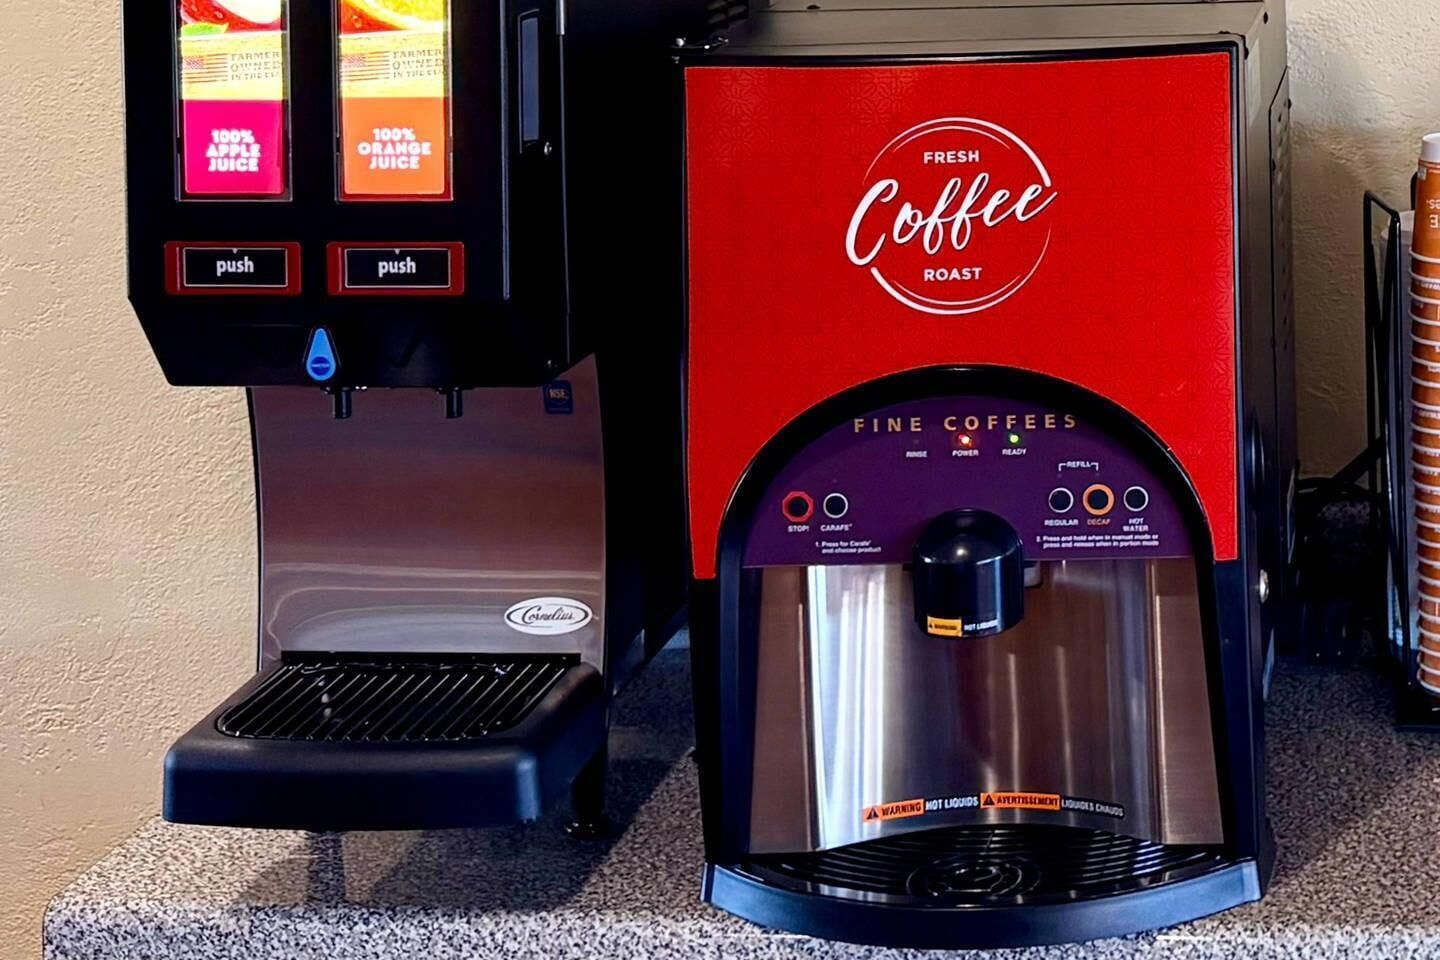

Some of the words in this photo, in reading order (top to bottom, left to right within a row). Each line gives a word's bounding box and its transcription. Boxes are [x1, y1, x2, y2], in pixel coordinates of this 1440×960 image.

[211, 129, 255, 144] 100%
[373, 128, 416, 141] 100%
[206, 143, 261, 158] APPLE
[357, 141, 432, 156] ORANGE
[208, 157, 259, 172] JUICE
[369, 155, 420, 170] JUICE
[923, 150, 980, 164] FRESH
[846, 172, 1058, 266] Coffee
[216, 256, 254, 277] push
[378, 257, 416, 278] push
[924, 267, 982, 282] ROAST
[854, 417, 922, 433] FINE
[944, 414, 1077, 431] COFFEES
[952, 449, 979, 457] POWER
[1002, 448, 1027, 456] READY
[1044, 519, 1079, 527] REGULAR
[1087, 518, 1111, 526] DECAF
[1129, 517, 1144, 525] HOT
[521, 604, 574, 625] Cornelius
[881, 802, 922, 817] WARNING
[925, 799, 943, 811] HOT
[944, 796, 979, 809] LIQUIDS
[997, 794, 1059, 807] AVERTISSEMENT
[1061, 798, 1094, 812] LIQUIDES
[1096, 803, 1124, 817] CHAUDS
